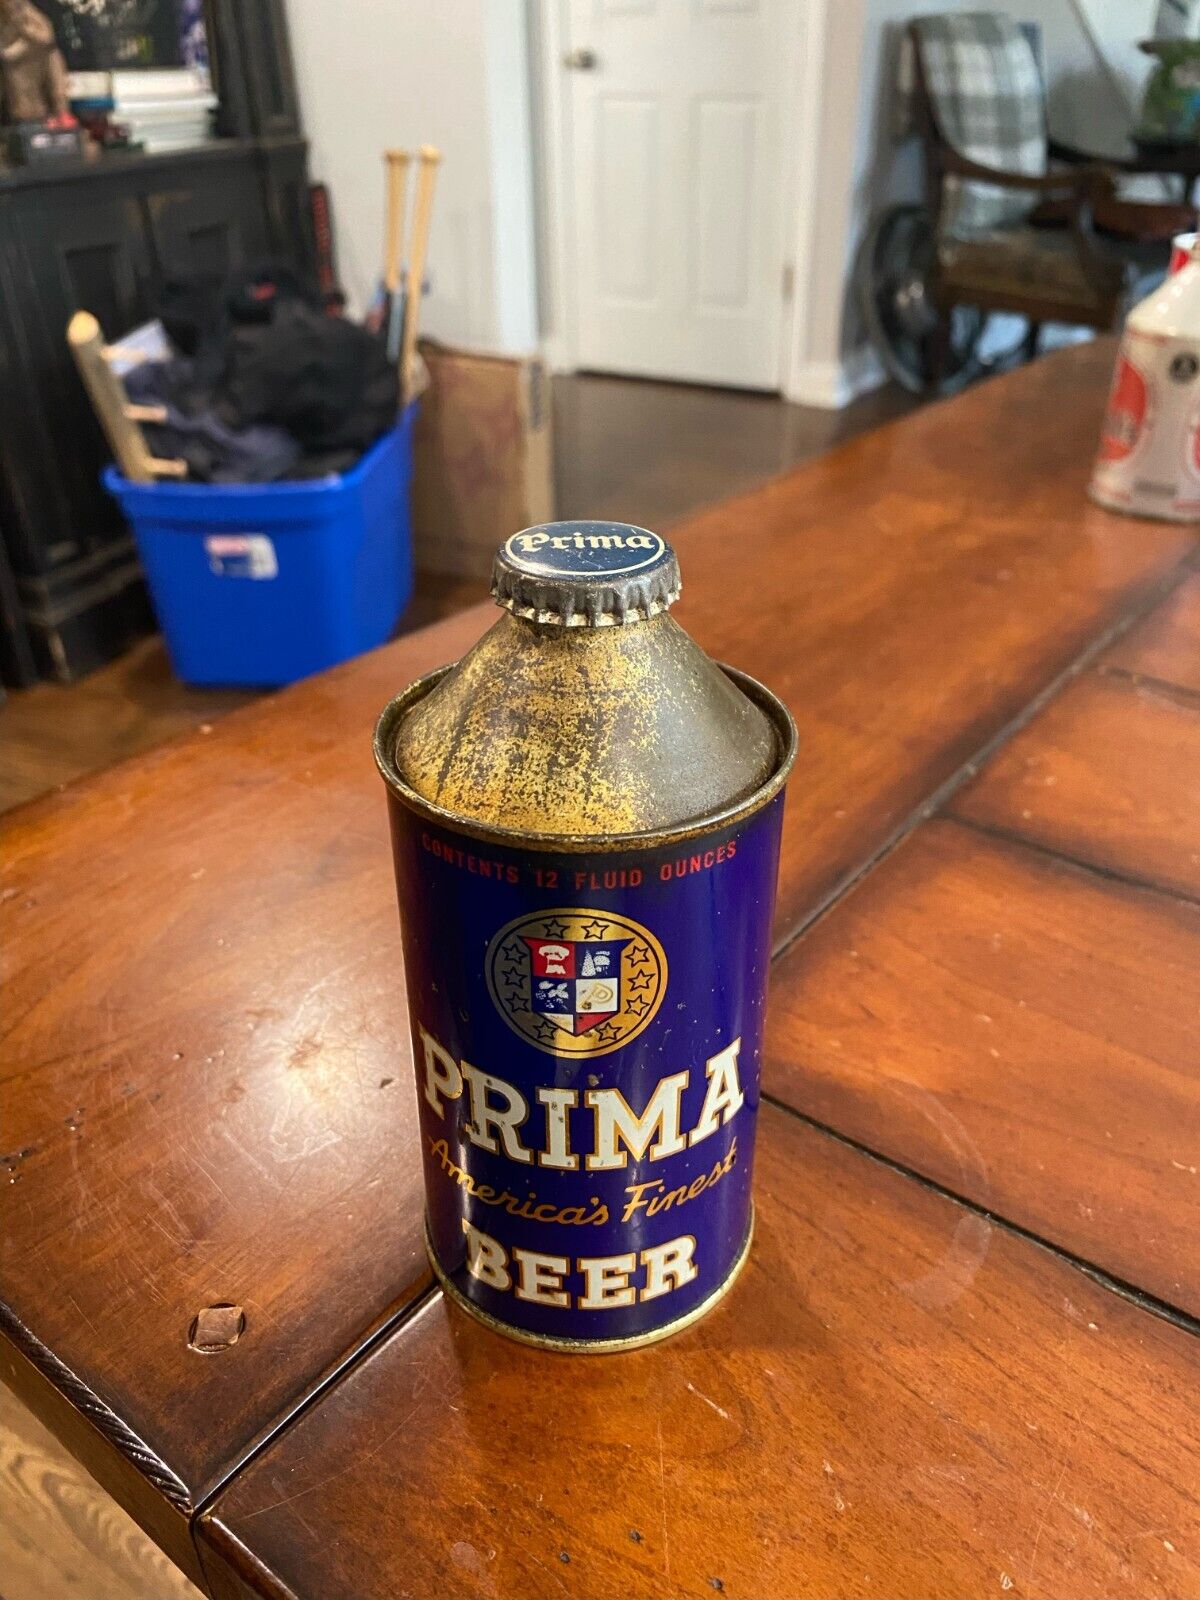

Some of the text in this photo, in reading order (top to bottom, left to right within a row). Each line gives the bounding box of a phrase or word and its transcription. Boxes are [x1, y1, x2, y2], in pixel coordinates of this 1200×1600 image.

[516, 532, 655, 552] Prima
[422, 833, 738, 890] CONTENTS 12 FLUID OUNCES
[419, 1026, 744, 1169] PRIMA
[428, 1136, 738, 1226] America's Finest
[461, 1217, 698, 1310] BEER
